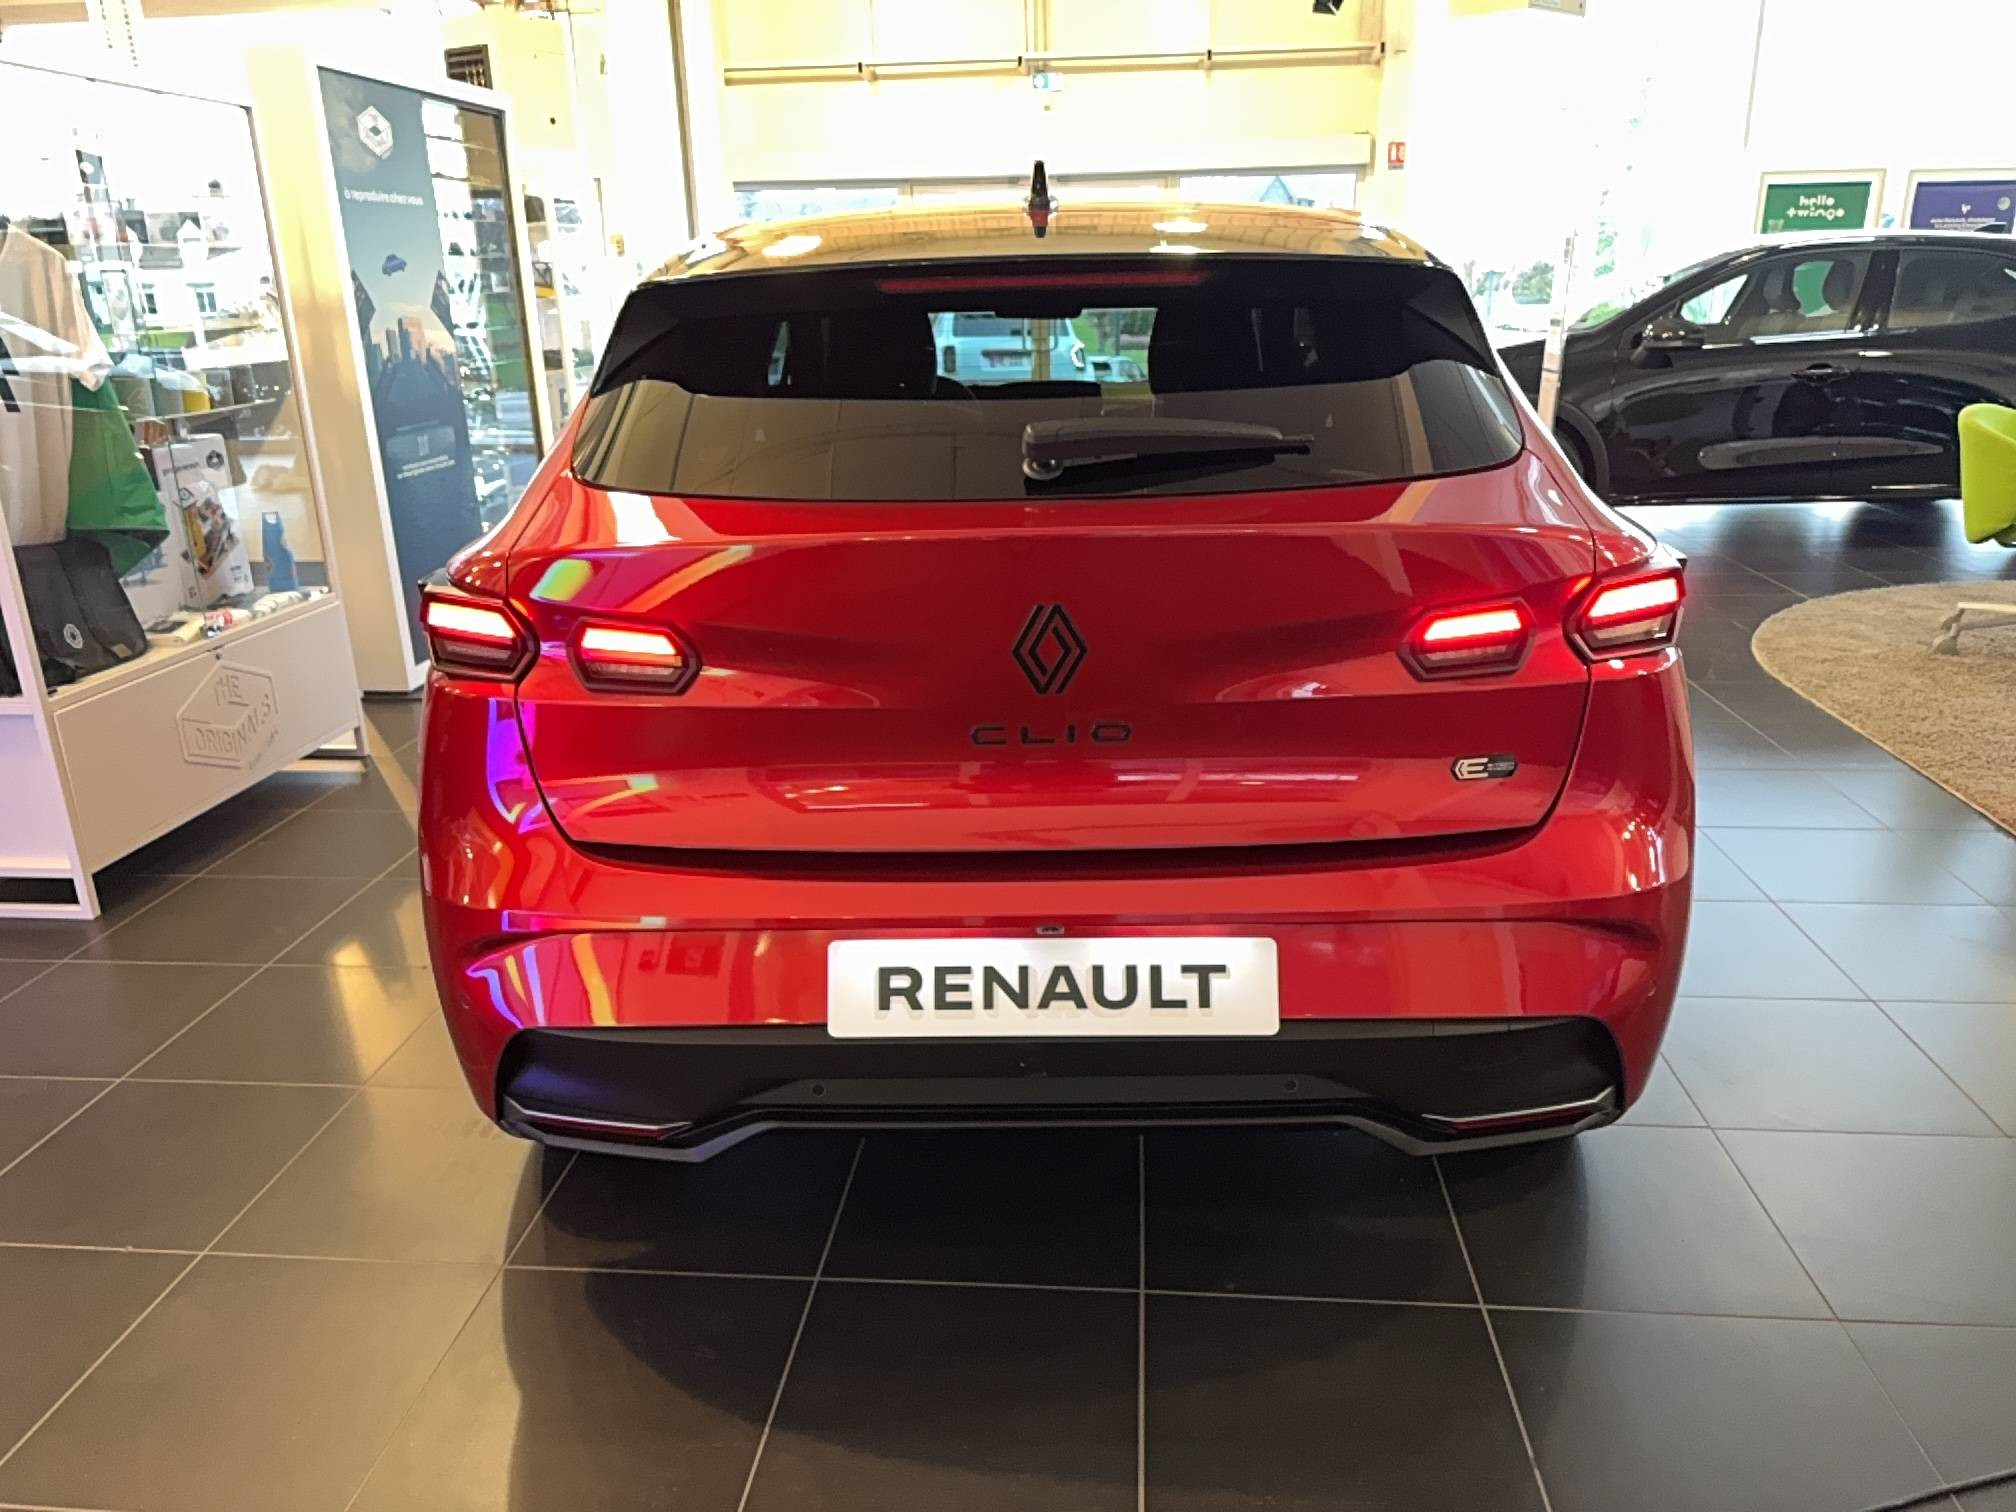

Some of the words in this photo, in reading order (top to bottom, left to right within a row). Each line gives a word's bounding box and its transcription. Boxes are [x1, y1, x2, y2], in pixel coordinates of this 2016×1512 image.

[1799, 195, 1835, 206] hello
[971, 723, 1132, 746] CLIO
[878, 964, 1227, 1011] RENAULT
